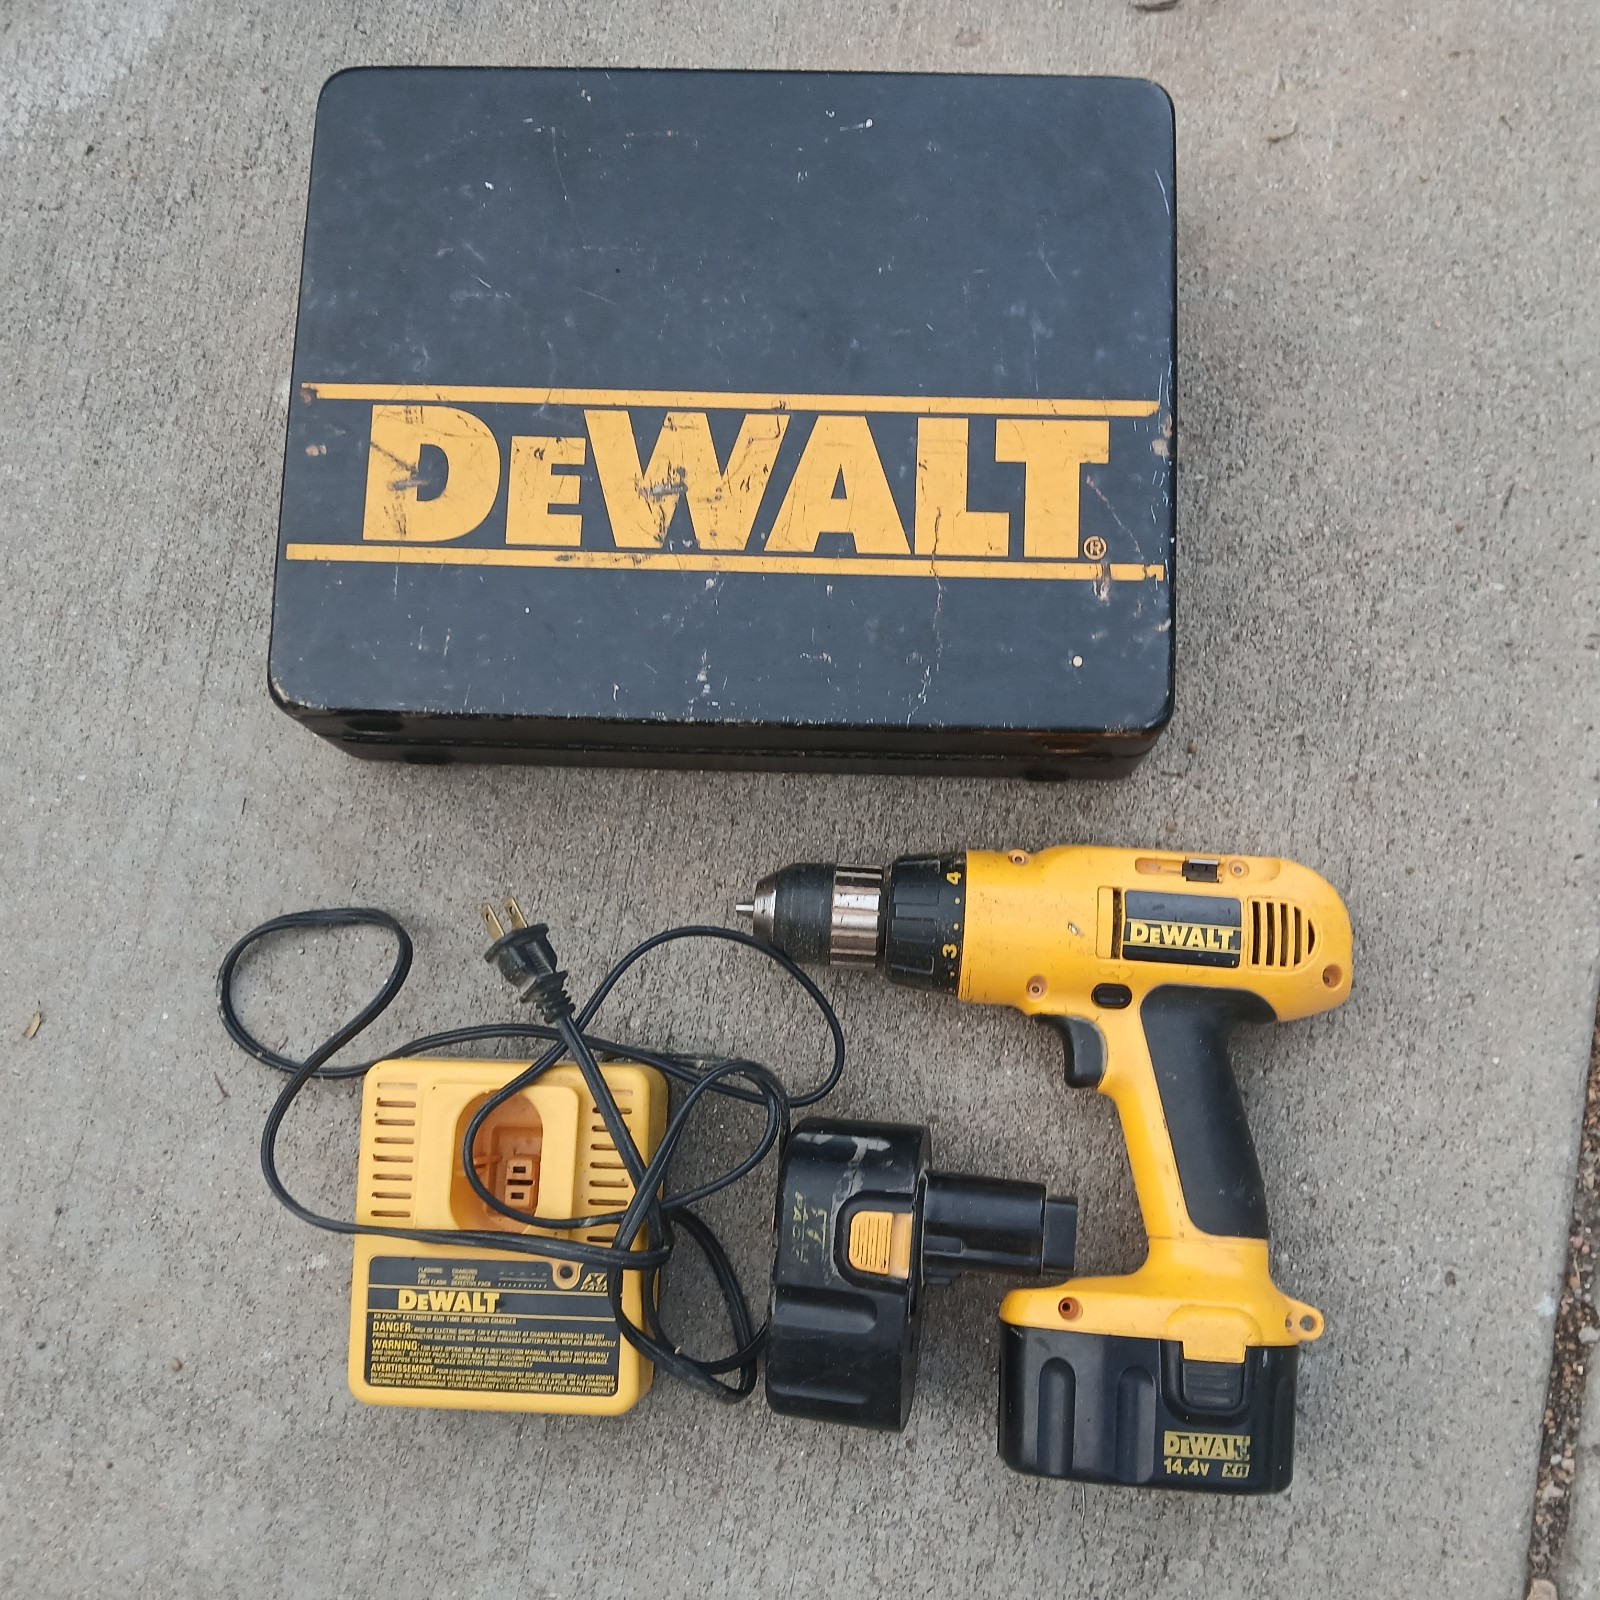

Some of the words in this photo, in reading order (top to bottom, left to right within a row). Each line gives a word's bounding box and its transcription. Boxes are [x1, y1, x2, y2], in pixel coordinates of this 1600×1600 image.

[946, 871, 962, 886] 4
[942, 943, 958, 960] 3
[398, 1290, 500, 1314] DEWALT
[372, 1321, 413, 1333] DANGER:
[372, 1339, 420, 1351] WARNING:
